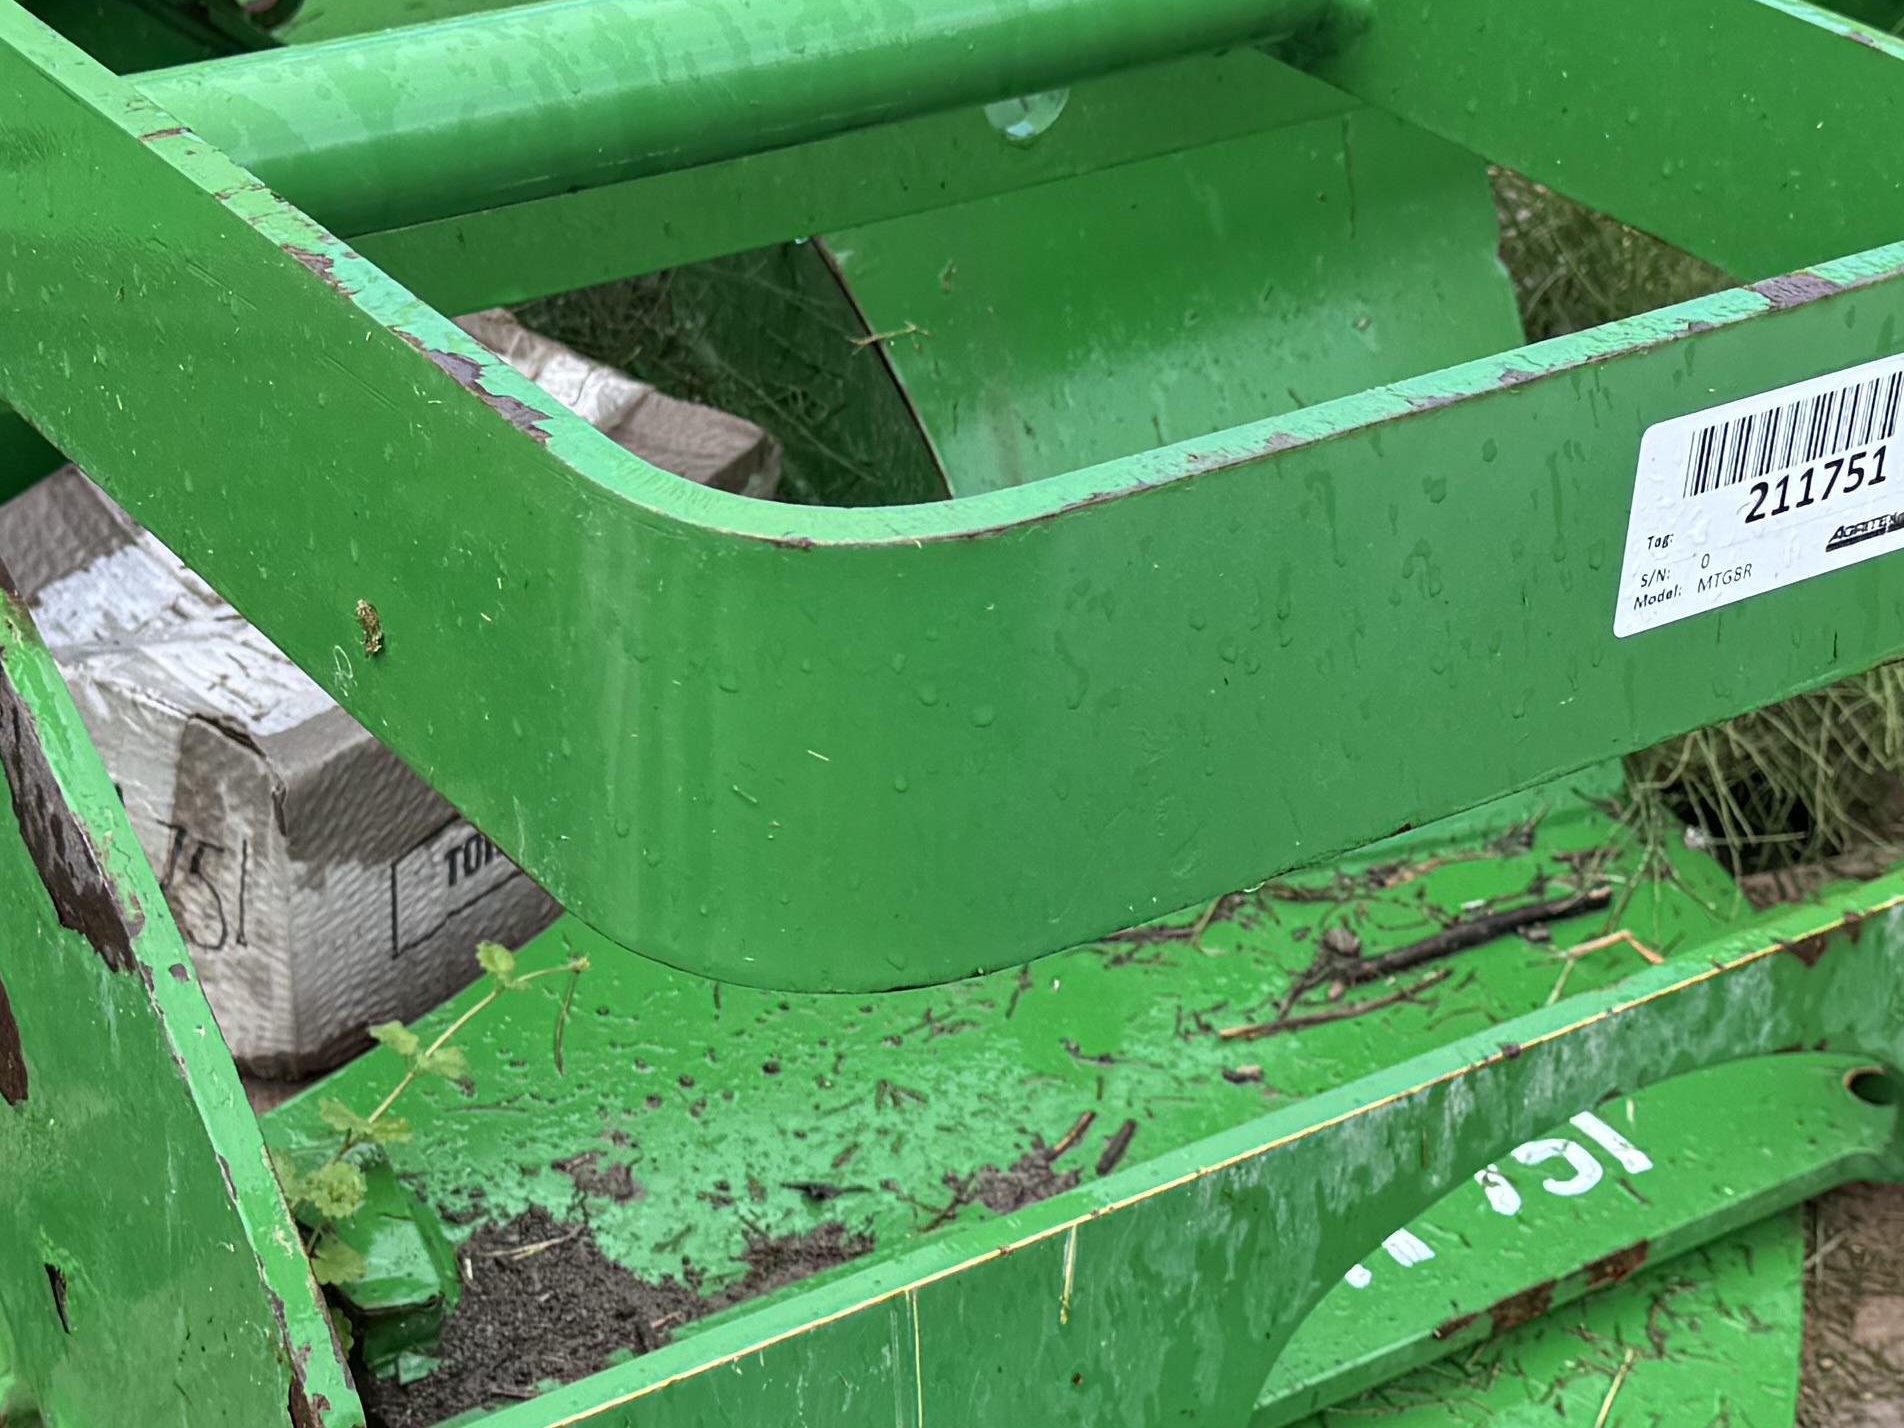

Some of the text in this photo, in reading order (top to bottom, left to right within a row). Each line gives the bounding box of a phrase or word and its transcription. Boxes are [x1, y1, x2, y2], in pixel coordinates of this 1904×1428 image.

[1744, 445, 1888, 524] 211751
[1647, 533, 1674, 550] Tag:
[1634, 563, 1752, 610] Model: MTG8R
[1641, 553, 1710, 588] S/N: 0
